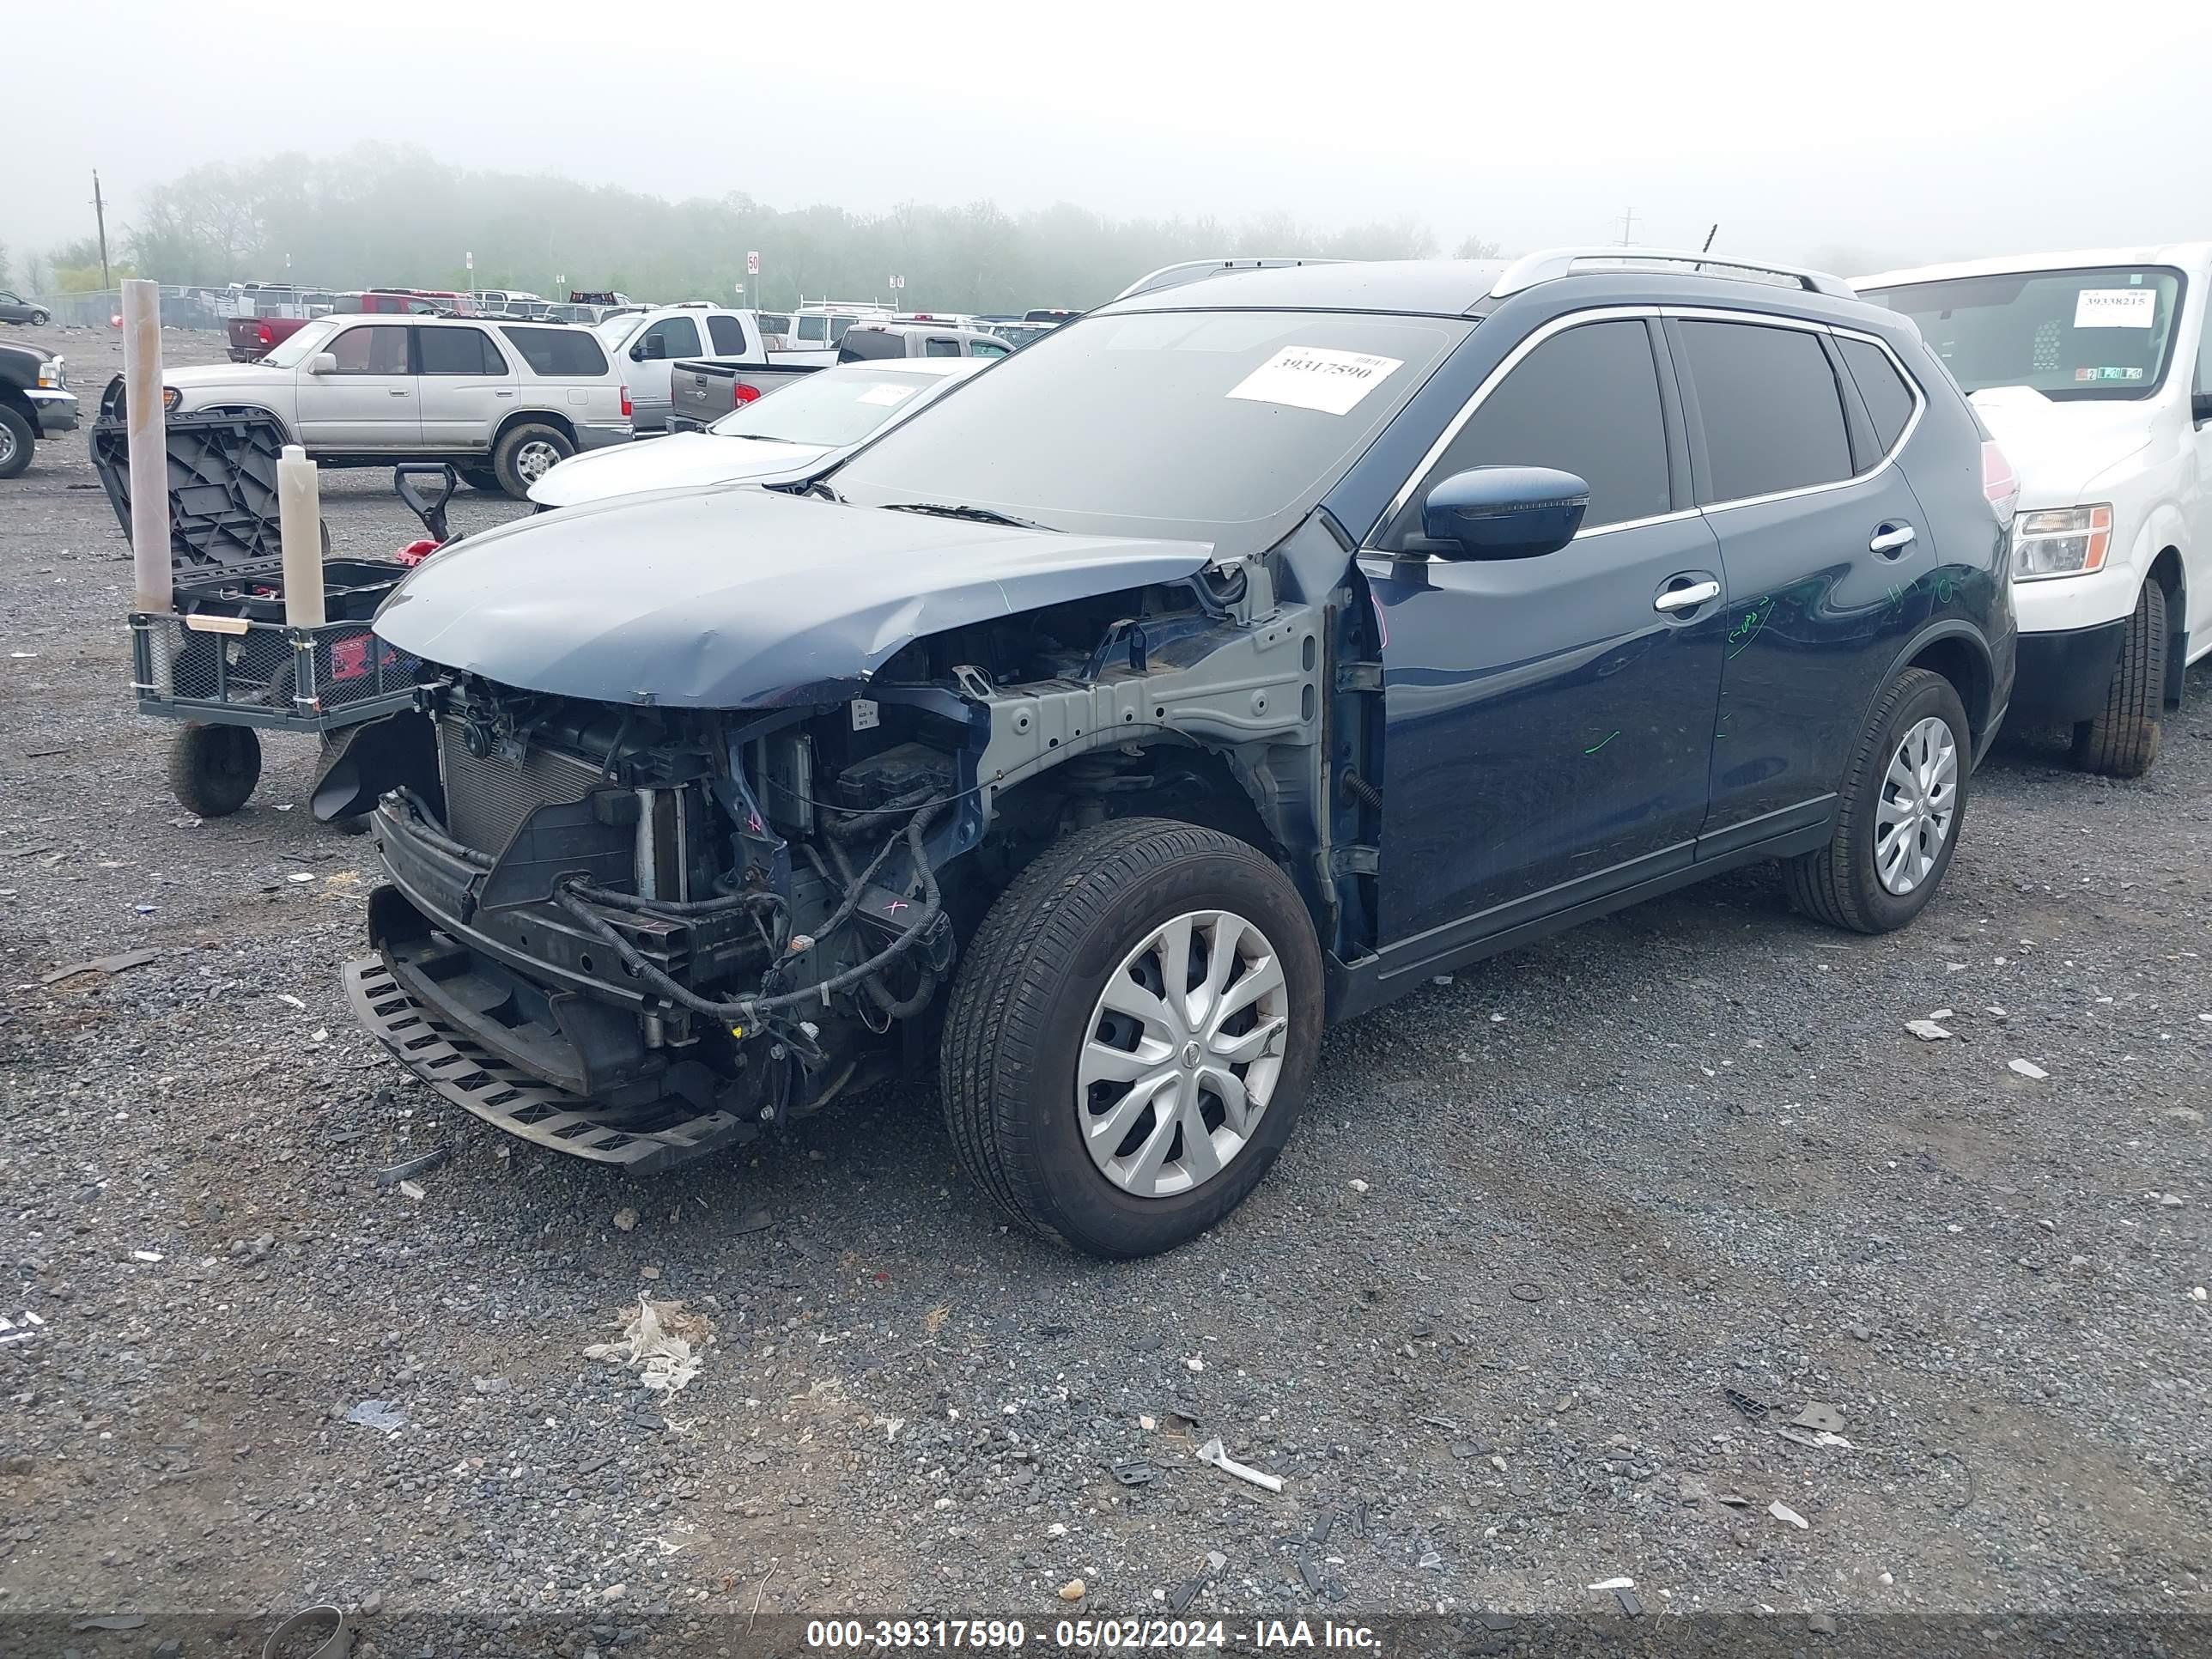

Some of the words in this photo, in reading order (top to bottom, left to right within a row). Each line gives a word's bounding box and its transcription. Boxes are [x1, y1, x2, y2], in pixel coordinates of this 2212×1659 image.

[749, 256, 758, 270] 50
[2086, 297, 2146, 306] 39338215
[1274, 358, 1373, 380] 39317590
